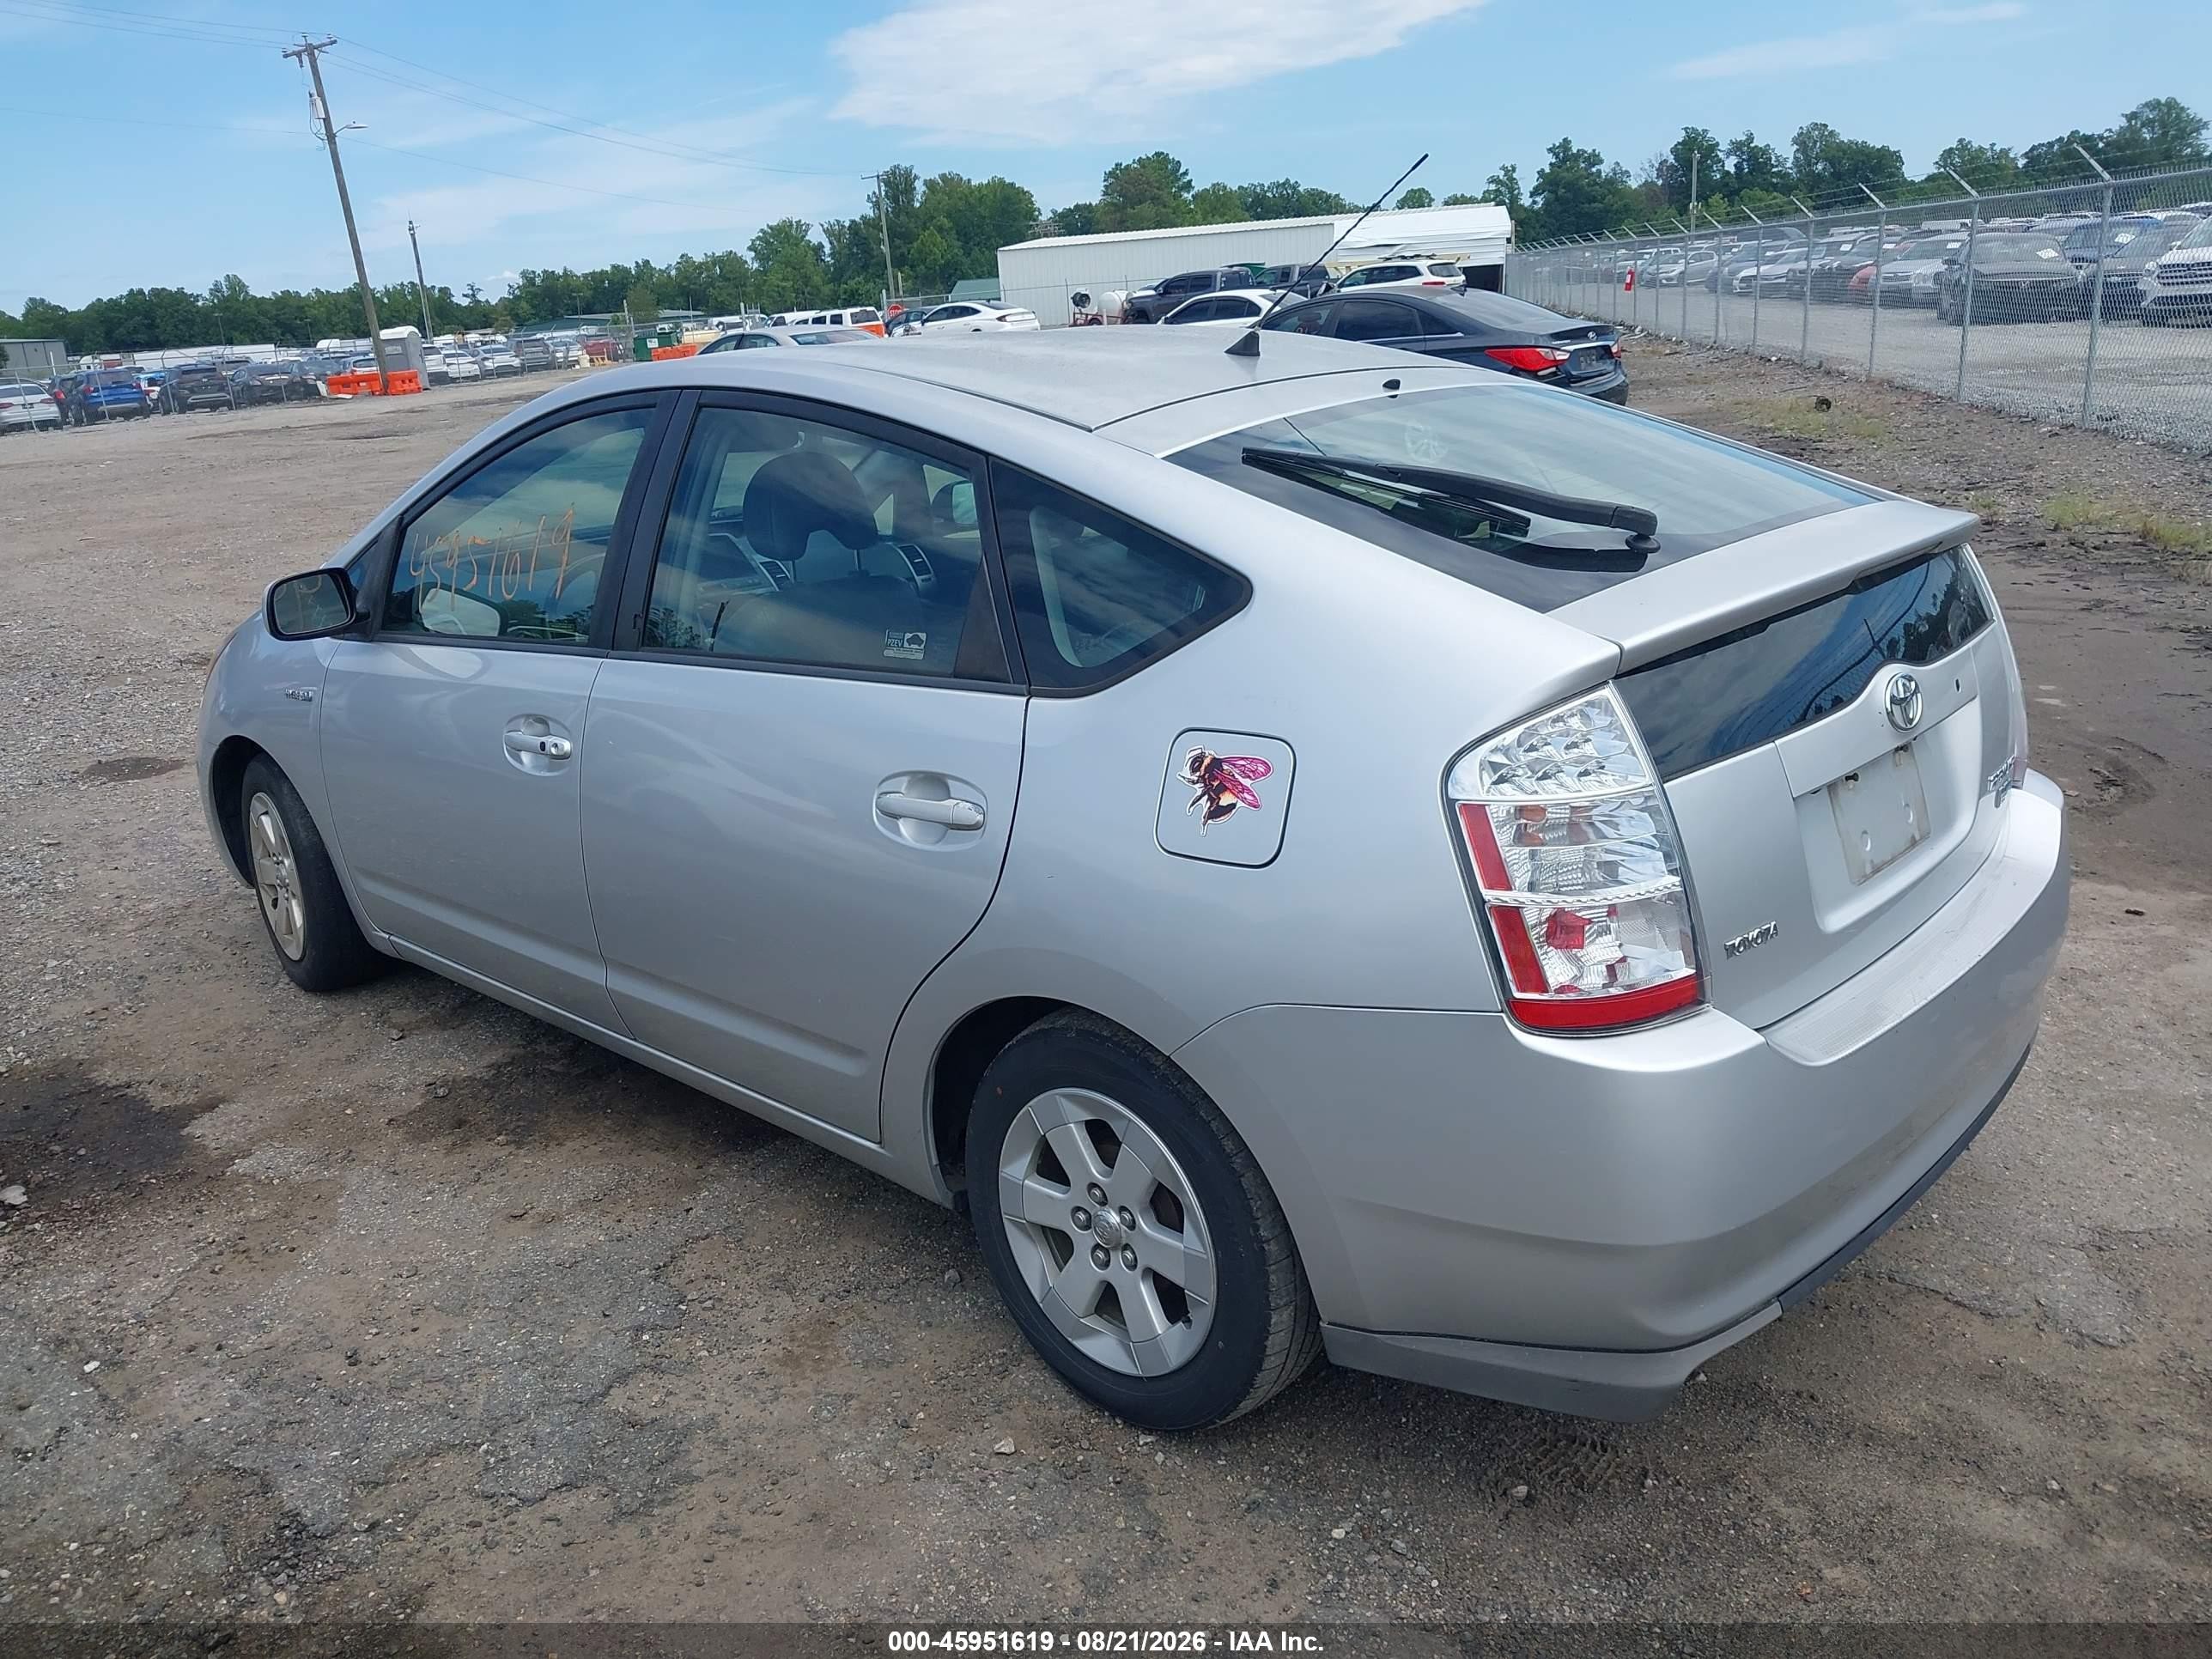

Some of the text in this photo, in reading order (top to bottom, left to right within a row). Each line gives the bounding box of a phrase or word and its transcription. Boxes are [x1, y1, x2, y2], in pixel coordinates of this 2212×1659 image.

[410, 502, 575, 611] 45951619
[887, 638, 903, 647] PZEV
[1723, 921, 1778, 960] TOYOTA
